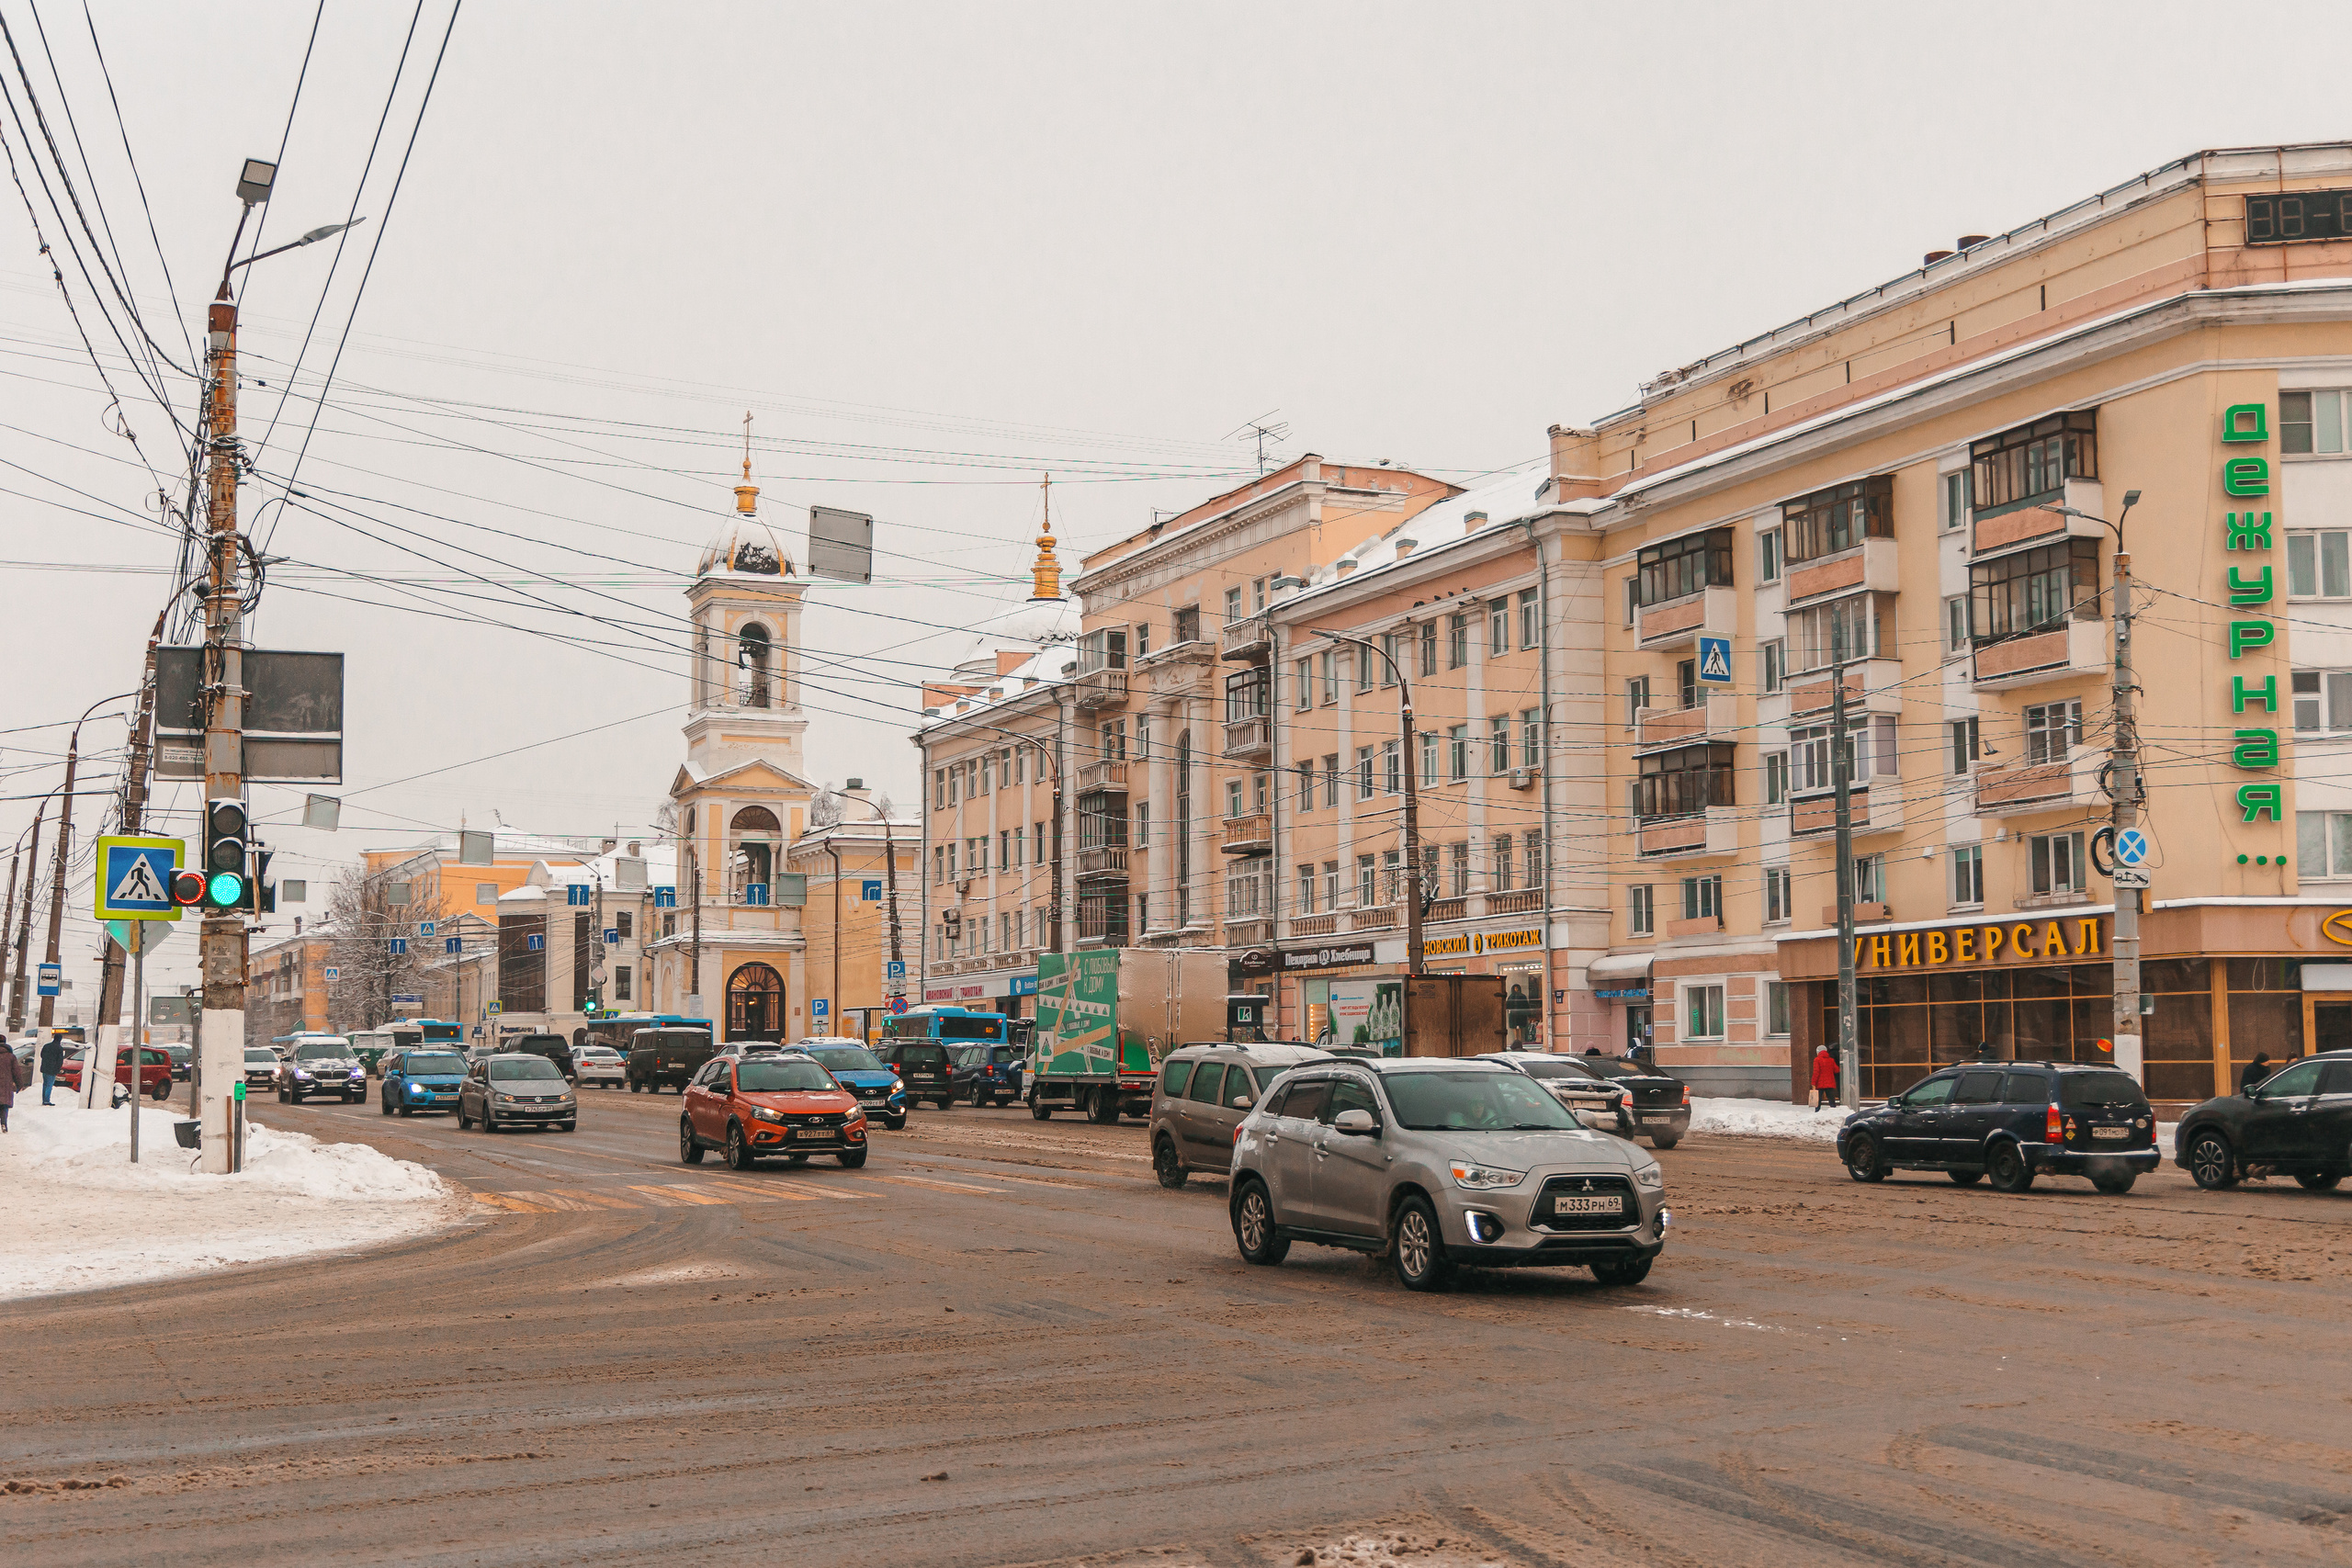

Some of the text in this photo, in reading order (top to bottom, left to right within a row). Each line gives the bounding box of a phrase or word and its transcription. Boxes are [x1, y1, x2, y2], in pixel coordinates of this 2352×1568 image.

[1406, 930, 1541, 957] НОВСКИЙ ТРИКОТАЖ
[1285, 948, 1371, 968] Пекарня Хлебница
